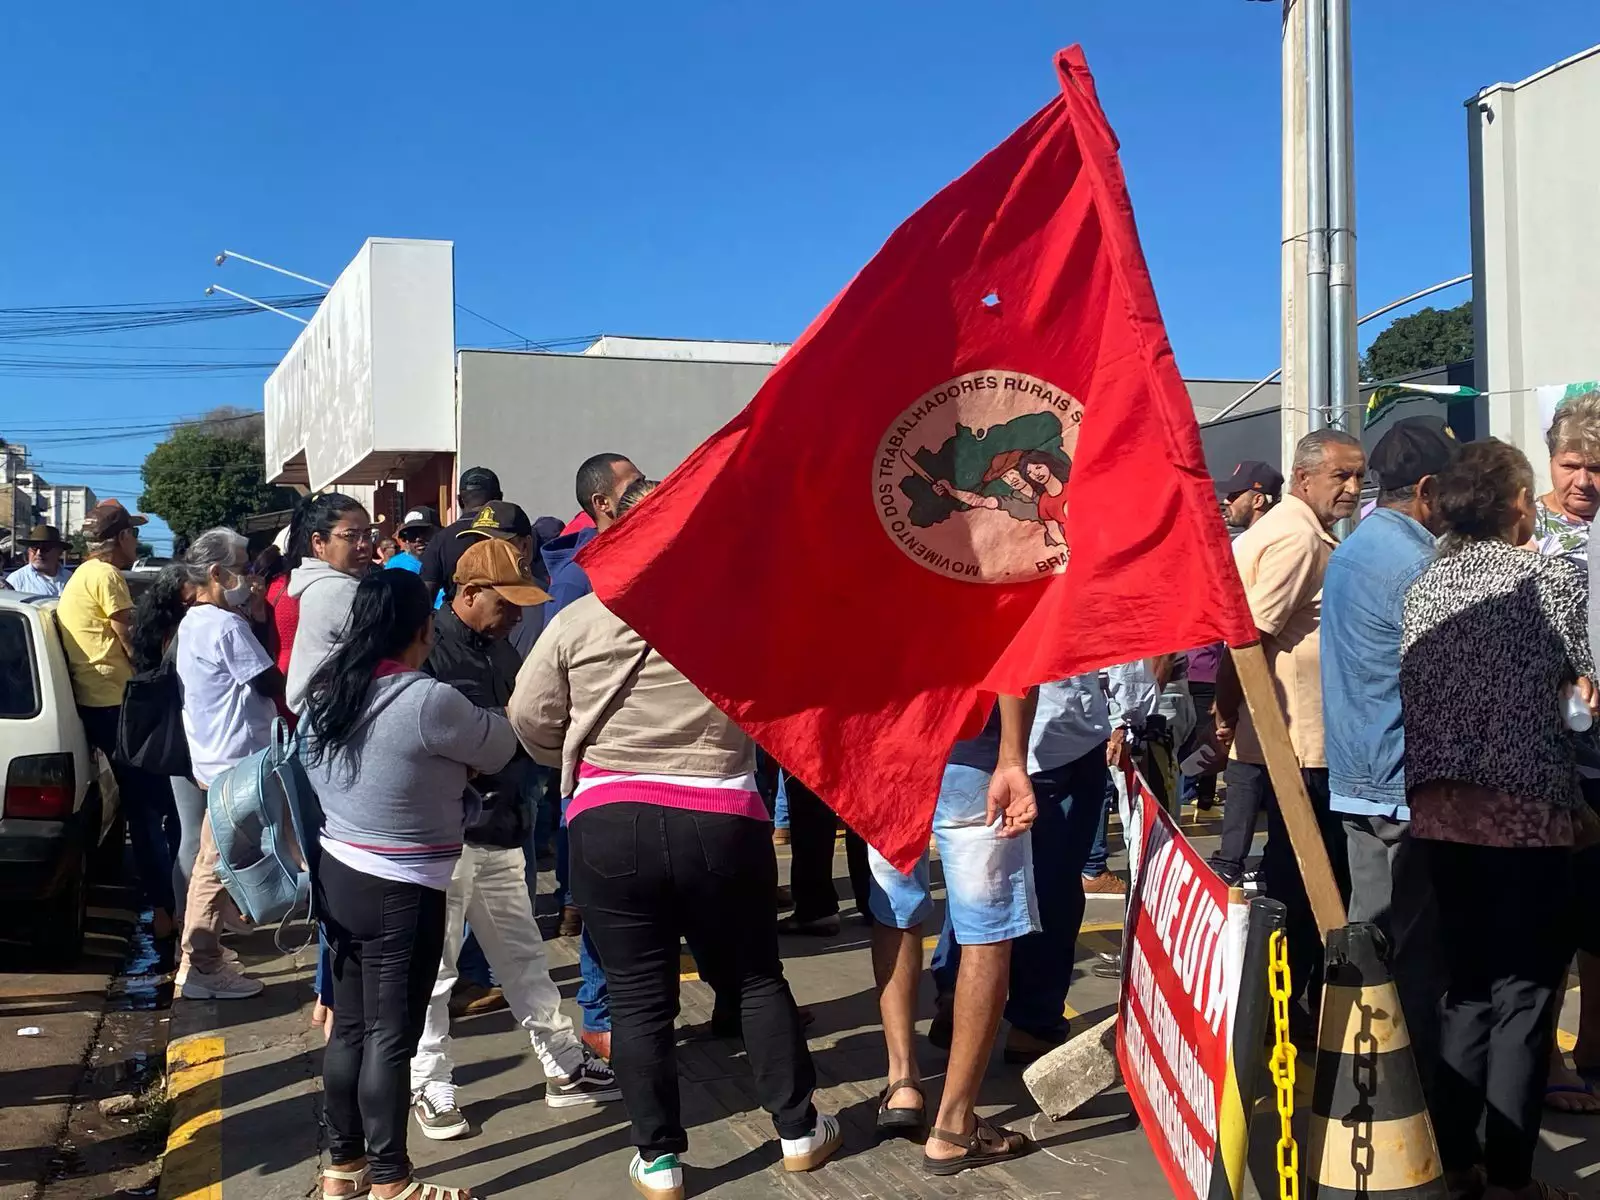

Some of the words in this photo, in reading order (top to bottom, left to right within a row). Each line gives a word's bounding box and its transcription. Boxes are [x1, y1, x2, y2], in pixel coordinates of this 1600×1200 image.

[879, 376, 998, 478] TRABALHADORES
[1004, 377, 1071, 412] RURAIS
[1071, 410, 1083, 427] S
[879, 483, 898, 518] DOS
[891, 520, 980, 577] MOVIMENTO
[1155, 849, 1194, 959] DE
[1172, 876, 1228, 1038] LUTA
[1178, 1033, 1217, 1144] AGRÁRIA
